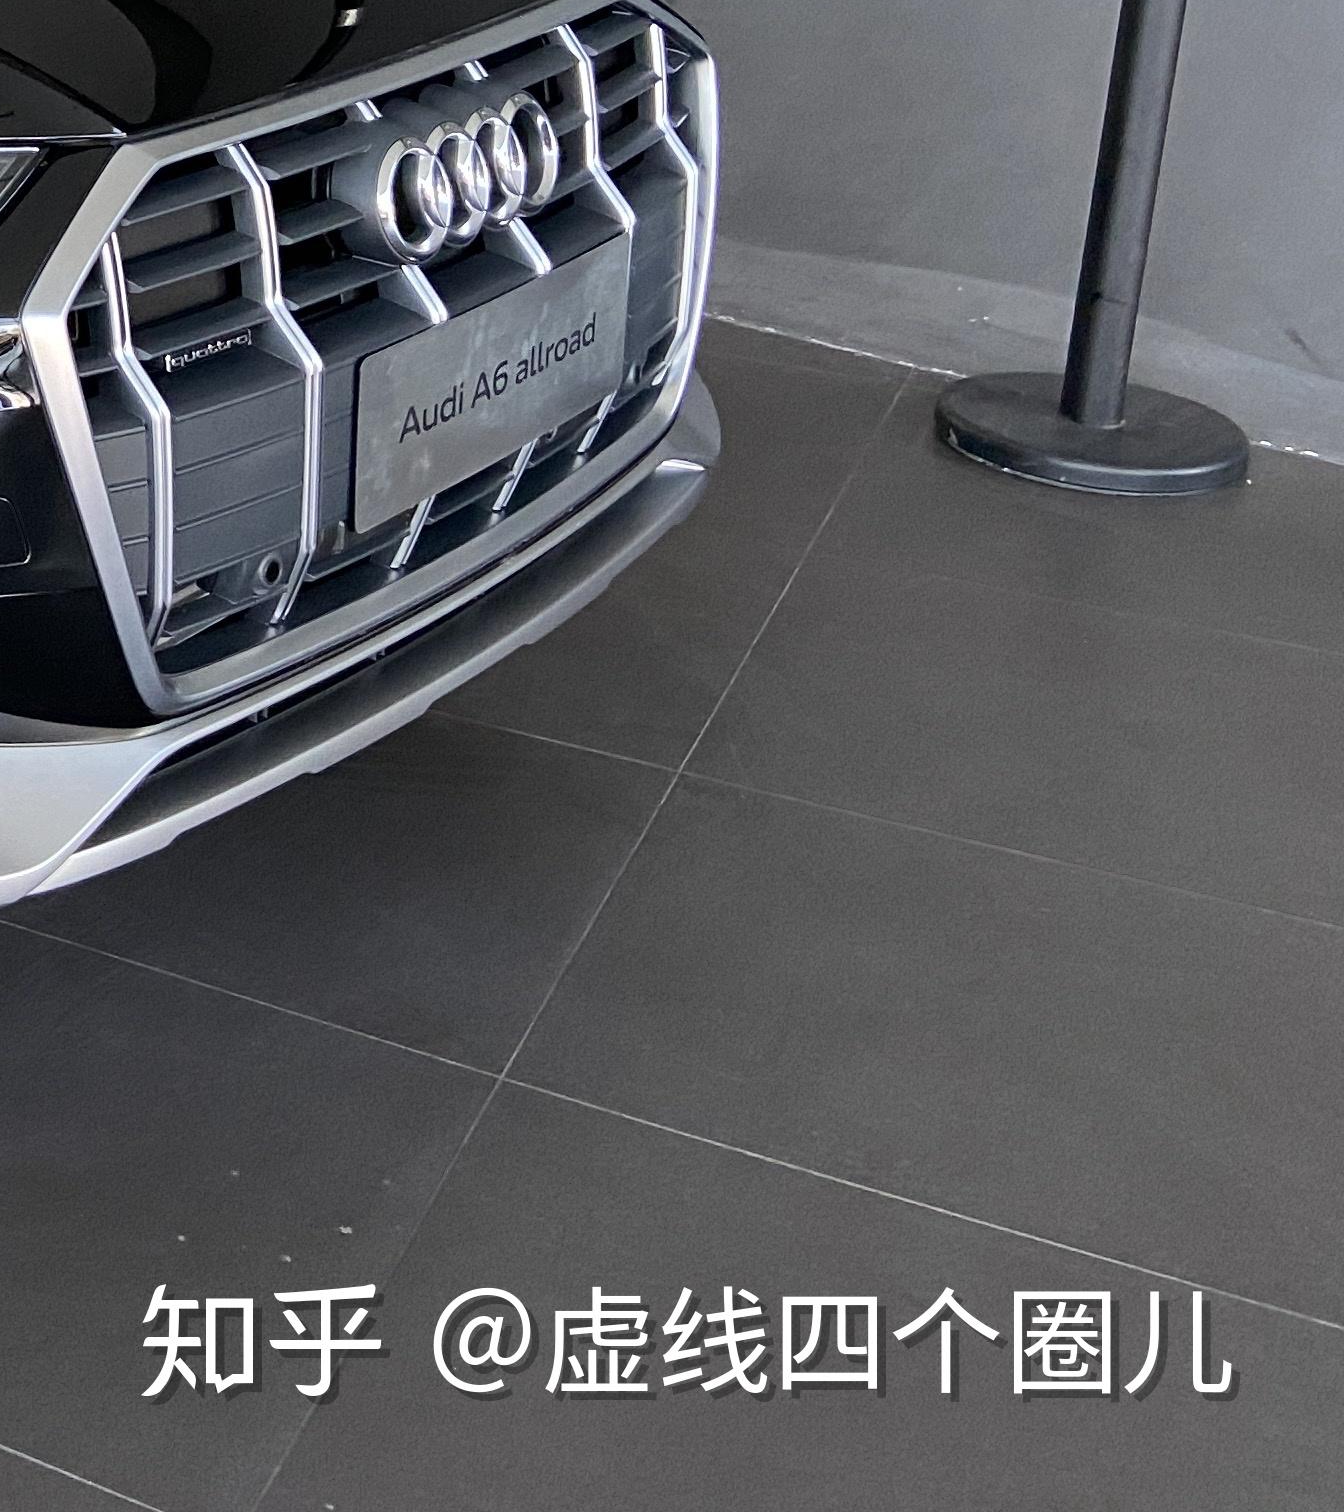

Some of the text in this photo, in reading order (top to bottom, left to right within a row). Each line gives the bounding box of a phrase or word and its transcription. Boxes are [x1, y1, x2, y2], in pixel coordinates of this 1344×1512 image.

[171, 333, 249, 368] quattro
[399, 311, 597, 444] Audi A6 allroad
